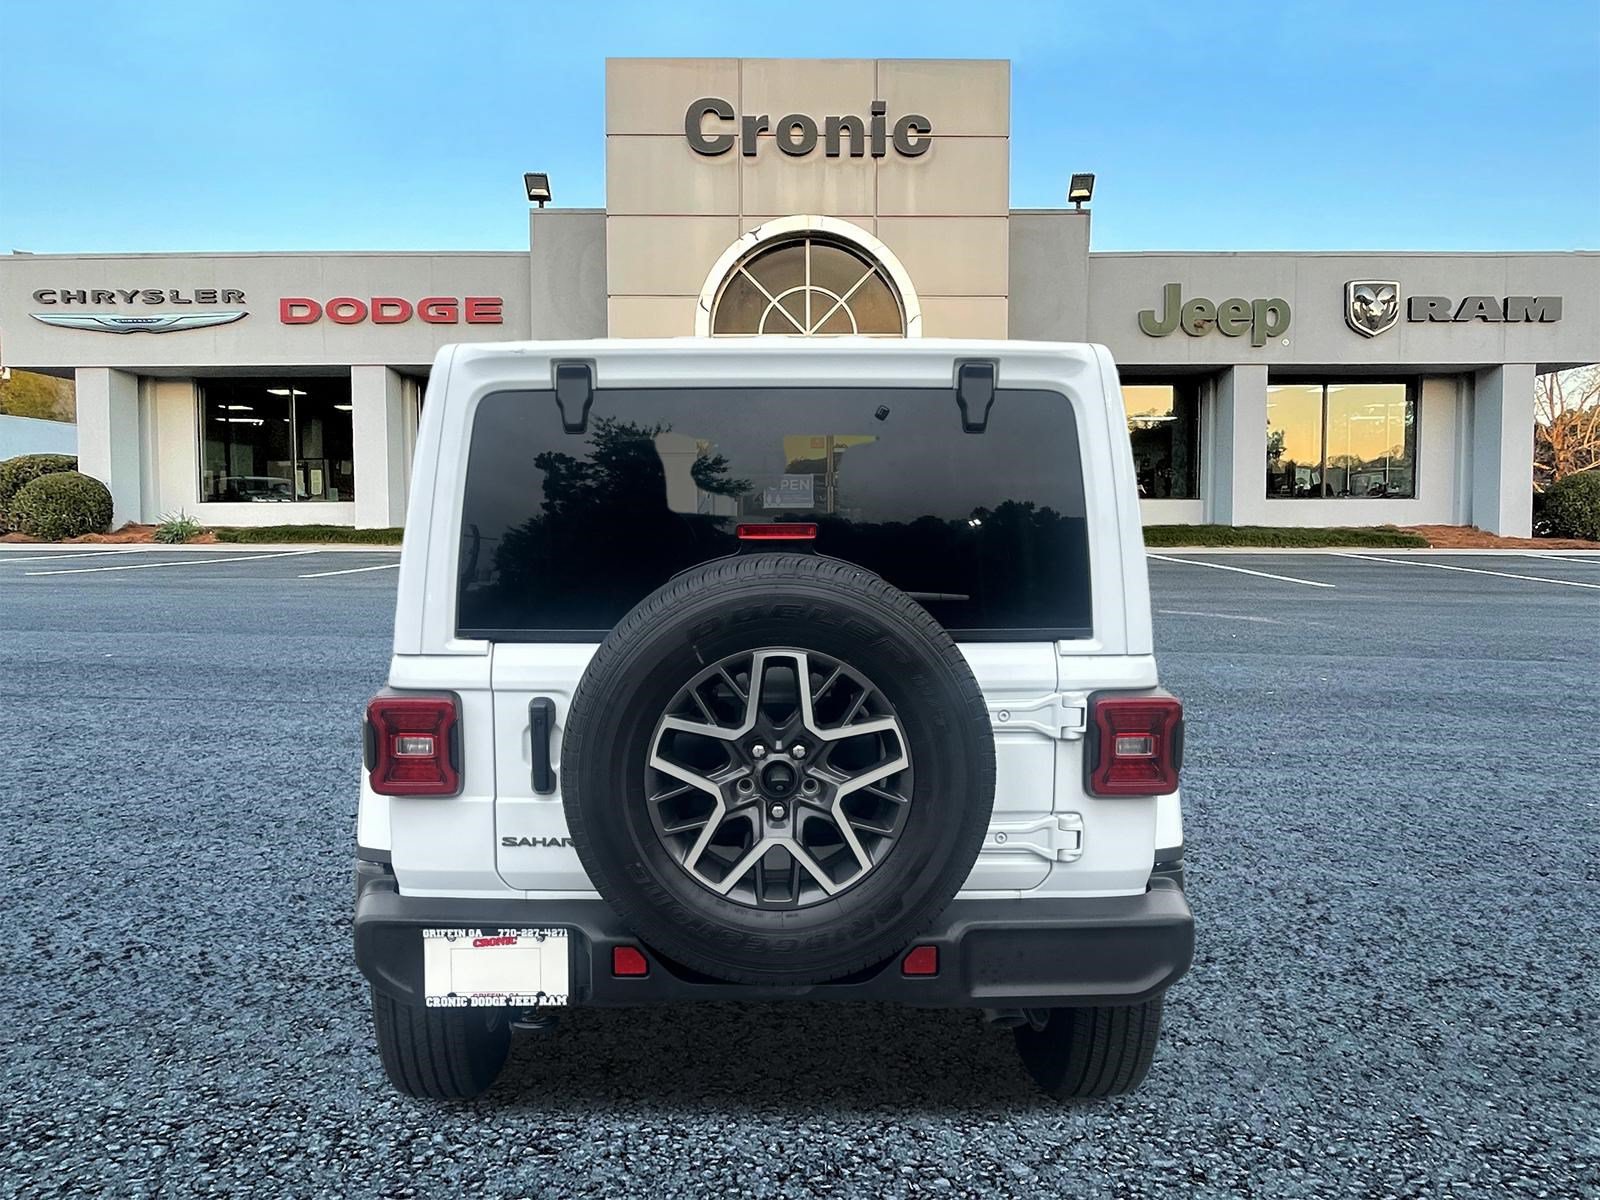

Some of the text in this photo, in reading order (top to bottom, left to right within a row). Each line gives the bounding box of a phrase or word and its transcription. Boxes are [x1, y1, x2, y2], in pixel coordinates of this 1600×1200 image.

[685, 97, 932, 158] Cronic
[32, 289, 246, 304] CHRYSLER
[1407, 296, 1562, 322] RAM
[280, 297, 503, 324] DODGE
[1138, 283, 1291, 347] Jeep
[688, 603, 911, 663] DUELER
[502, 837, 575, 847] SAHAR
[626, 861, 903, 955] BRIDGESTONE
[426, 995, 567, 1007] CRONIC DODGE JEEP RAM
